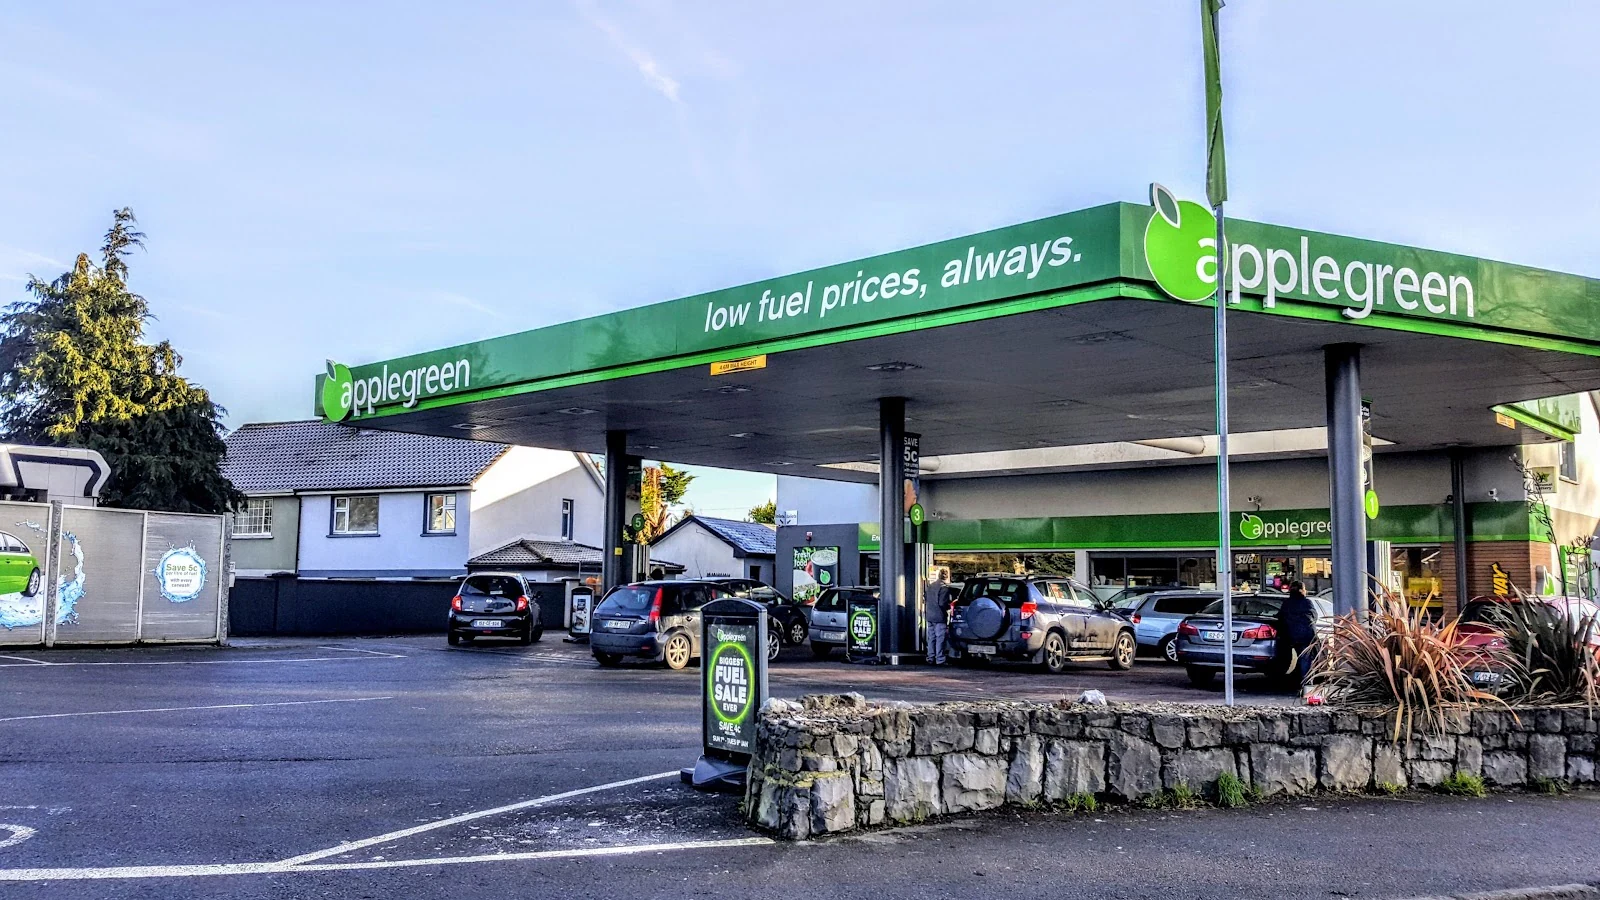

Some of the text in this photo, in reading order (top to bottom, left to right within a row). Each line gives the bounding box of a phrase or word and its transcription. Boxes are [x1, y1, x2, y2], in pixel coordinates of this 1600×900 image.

[1195, 236, 1475, 319] applegreen
[704, 236, 1082, 332] low fuel prices, always.
[340, 358, 471, 417] applegreen
[903, 436, 918, 447] SAVE
[1370, 497, 1375, 512] 1
[914, 508, 920, 520] 3
[635, 518, 641, 528] 5
[1252, 518, 1331, 538] applegre
[794, 550, 811, 559] Fresh
[853, 626, 871, 634] SALE
[719, 656, 744, 666] BIGGEST
[715, 665, 747, 685] FUEL
[714, 683, 747, 705] SALE
[722, 702, 738, 712] EVER
[718, 721, 733, 731] SAVE
